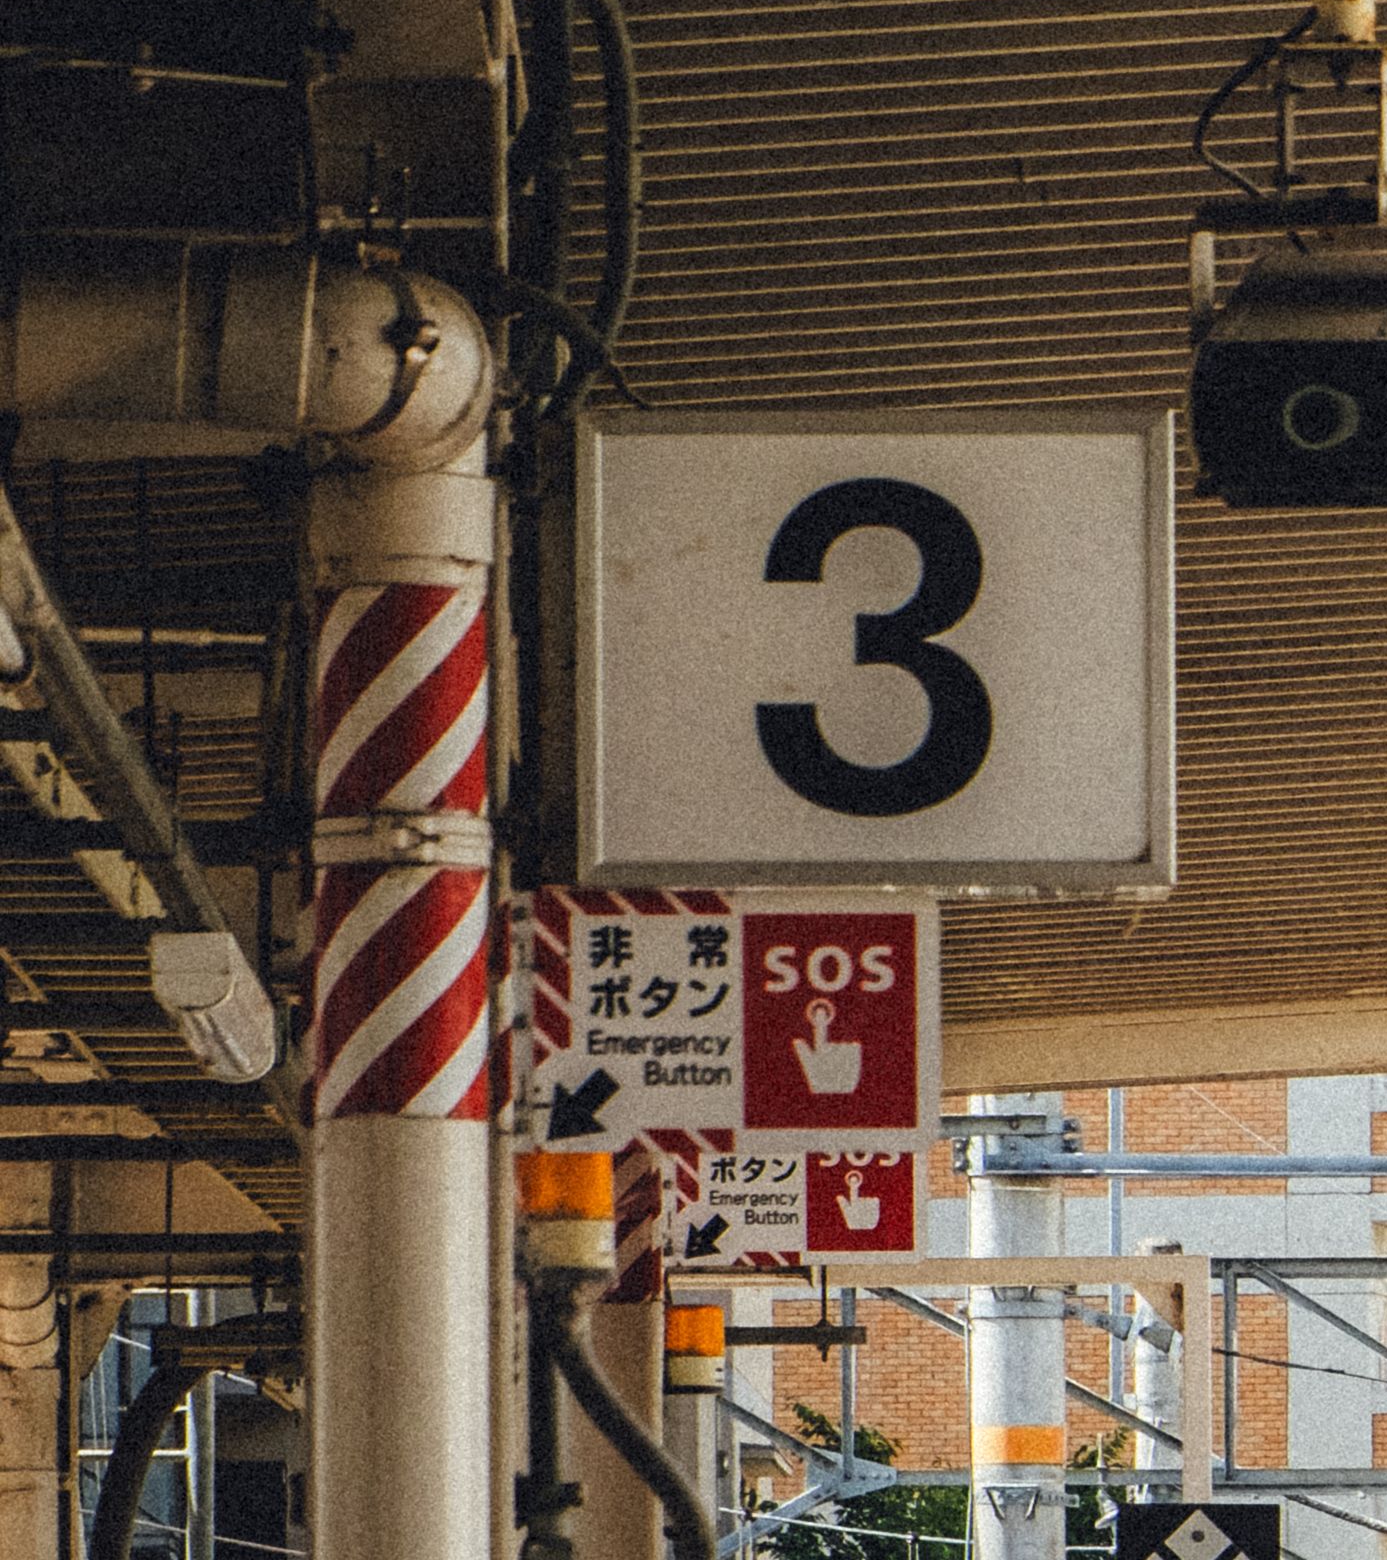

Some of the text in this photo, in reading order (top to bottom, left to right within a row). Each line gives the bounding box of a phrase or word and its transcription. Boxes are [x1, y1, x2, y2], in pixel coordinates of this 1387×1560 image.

[755, 476, 994, 816] 3
[588, 924, 731, 968] 非常
[763, 945, 896, 993] SOS
[589, 976, 730, 1019] ボタン
[586, 1031, 731, 1058] Emergency
[643, 1060, 732, 1086] Button
[710, 1156, 797, 1183] ボタン
[709, 1190, 798, 1208] Emergency
[744, 1210, 799, 1226] Button
